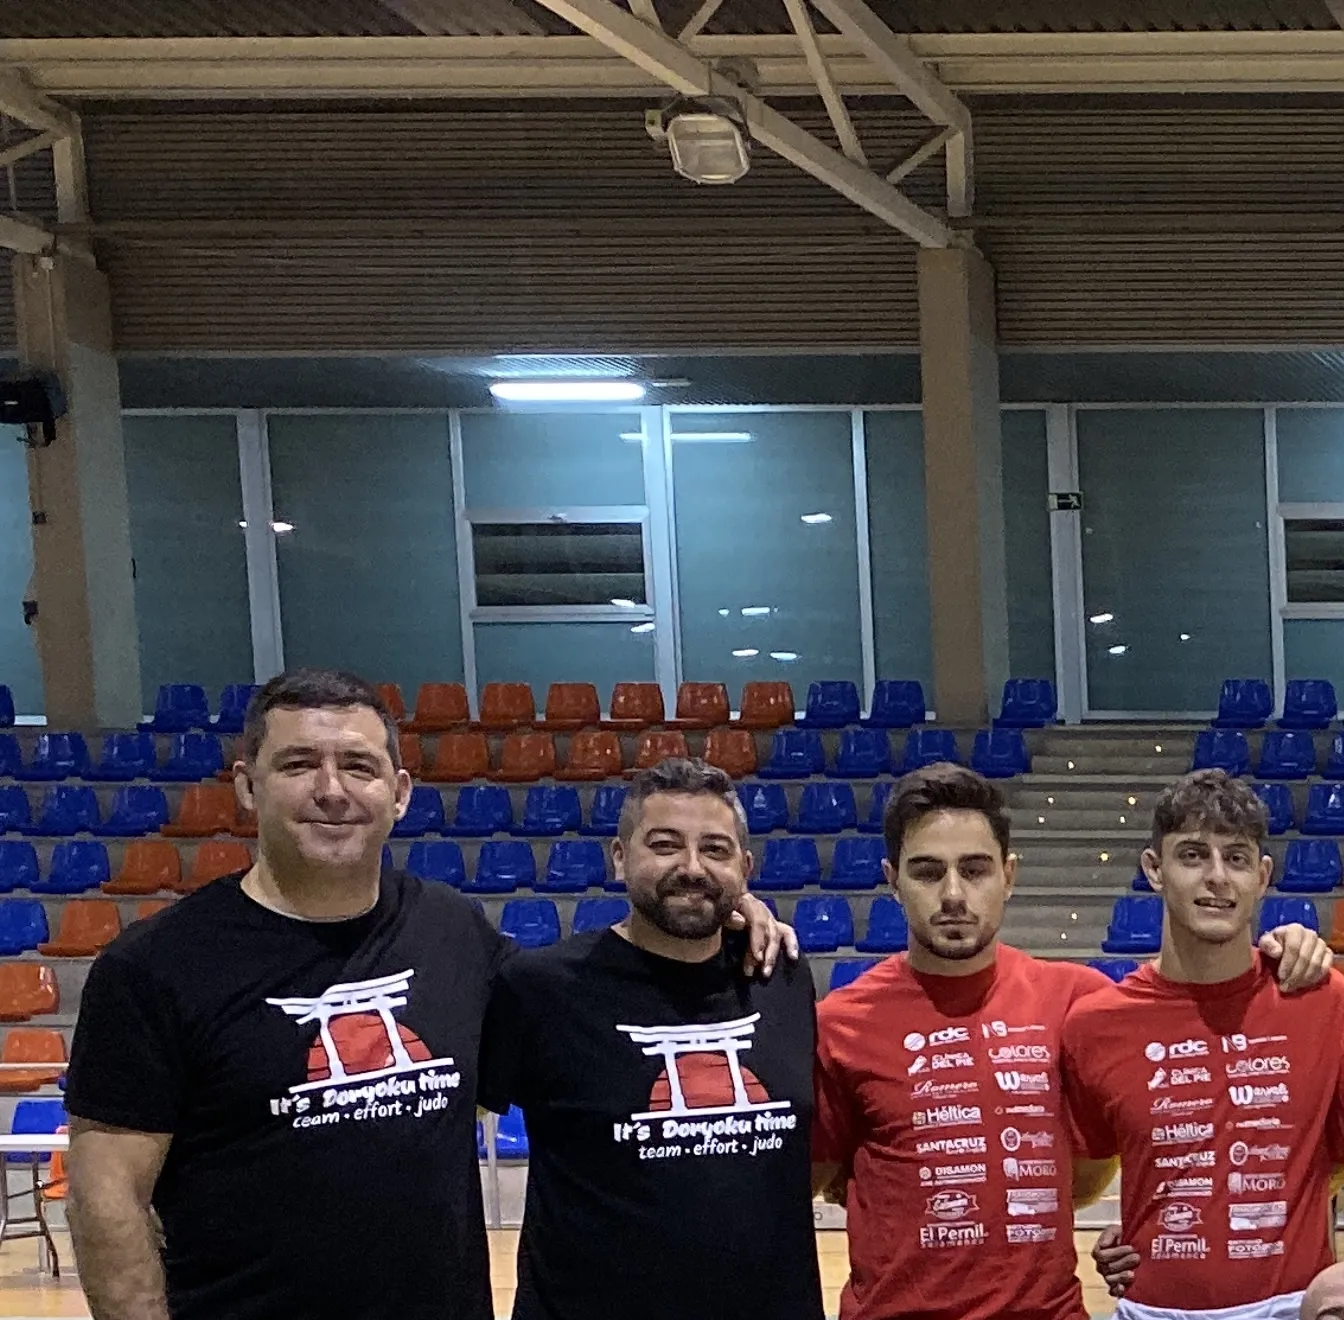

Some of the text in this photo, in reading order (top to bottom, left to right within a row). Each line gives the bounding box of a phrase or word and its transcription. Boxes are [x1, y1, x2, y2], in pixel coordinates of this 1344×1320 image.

[929, 1027, 968, 1043] rdc
[1169, 1040, 1207, 1054] rdc
[269, 1094, 311, 1116] It's
[418, 1070, 461, 1091] time
[353, 1100, 402, 1120] effort
[413, 1092, 448, 1117] judo
[613, 1111, 796, 1142] It's Doryoku time
[638, 1133, 783, 1160] team effort judo
